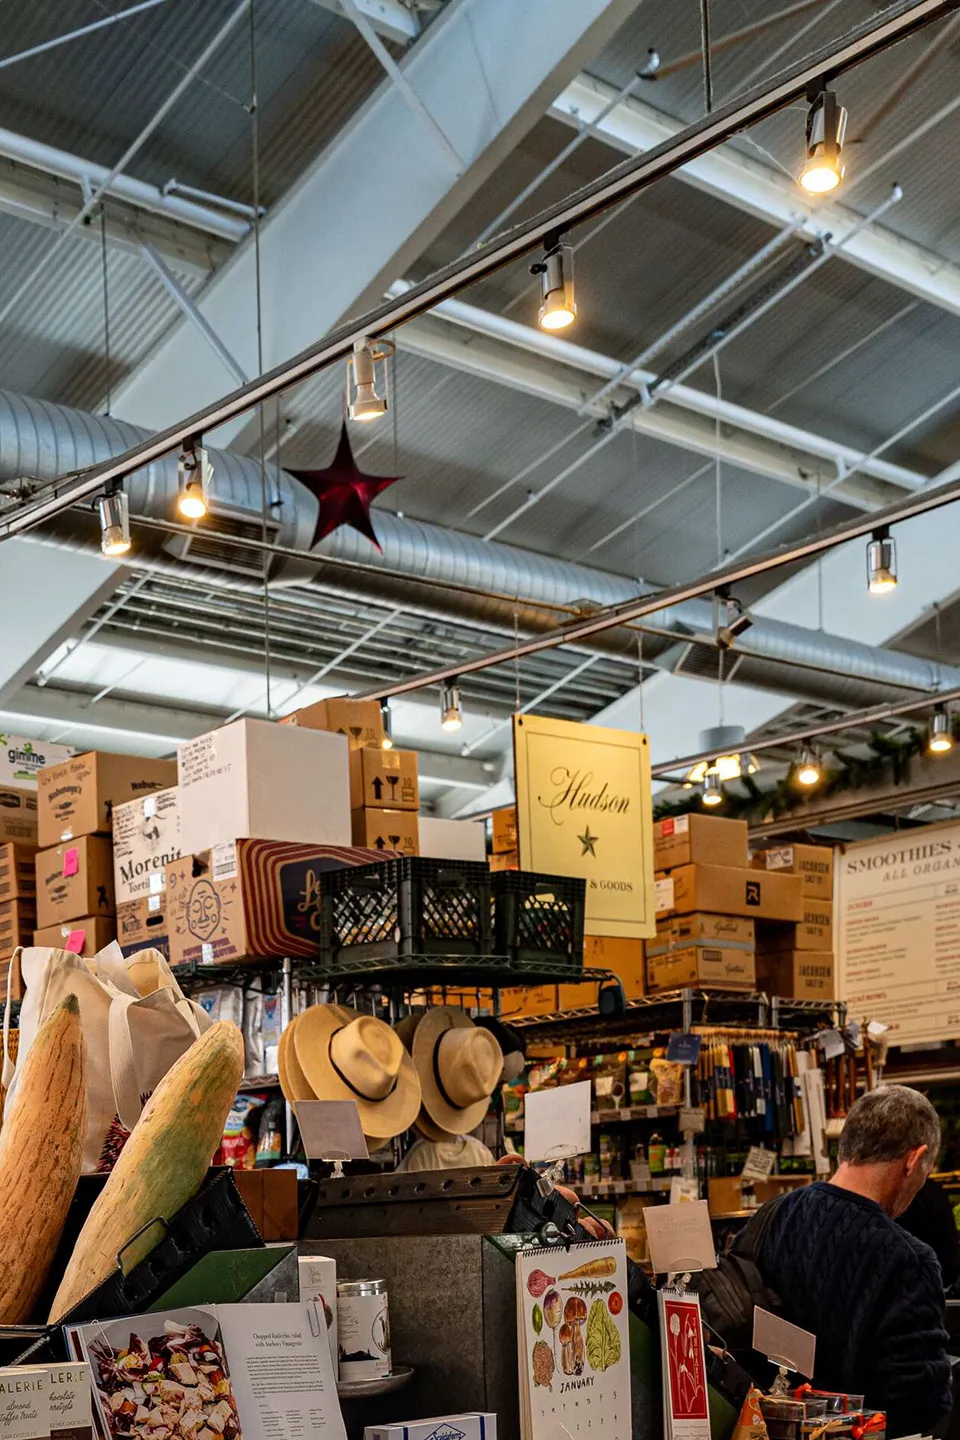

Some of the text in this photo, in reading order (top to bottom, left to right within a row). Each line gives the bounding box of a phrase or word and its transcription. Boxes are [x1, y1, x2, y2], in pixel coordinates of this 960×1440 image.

[8, 748, 45, 764] gimme
[538, 766, 630, 825] Hudson
[847, 840, 952, 874] SMOOTHIES
[882, 868, 908, 882] ALL
[590, 880, 633, 892] & GOODS
[560, 1377, 595, 1393] JANUARY
[6, 1401, 31, 1411] almond
[0, 1411, 37, 1426] toffee treats
